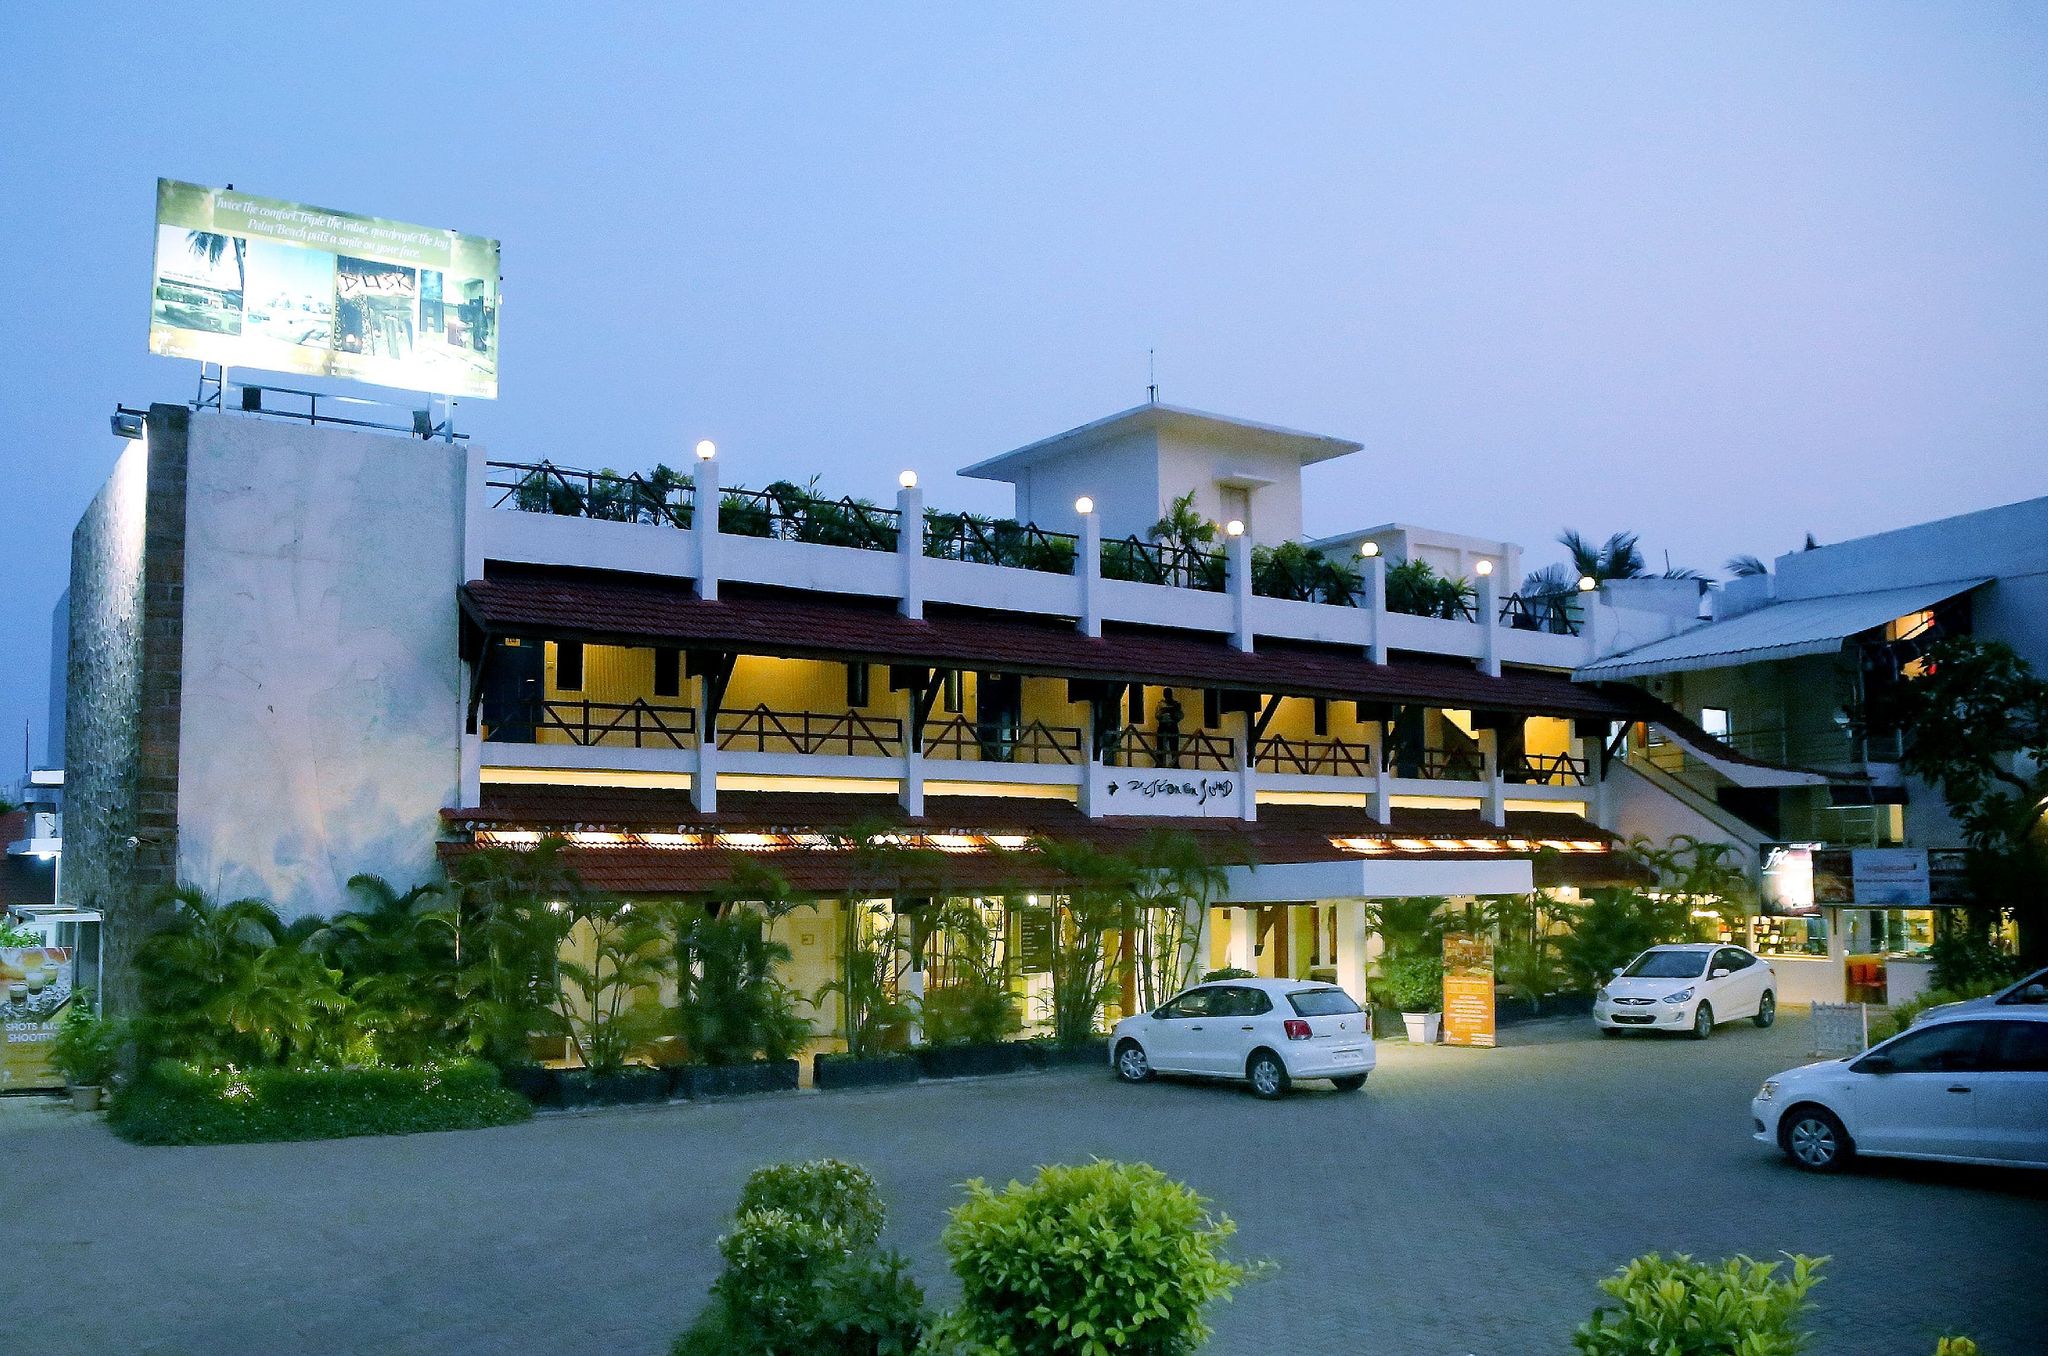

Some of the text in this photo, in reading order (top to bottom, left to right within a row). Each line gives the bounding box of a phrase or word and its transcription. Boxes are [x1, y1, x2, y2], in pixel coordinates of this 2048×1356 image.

[216, 197, 241, 211] Twice
[247, 218, 274, 234] Palm
[275, 223, 306, 241] Beach
[5, 1022, 38, 1031] SHOTS
